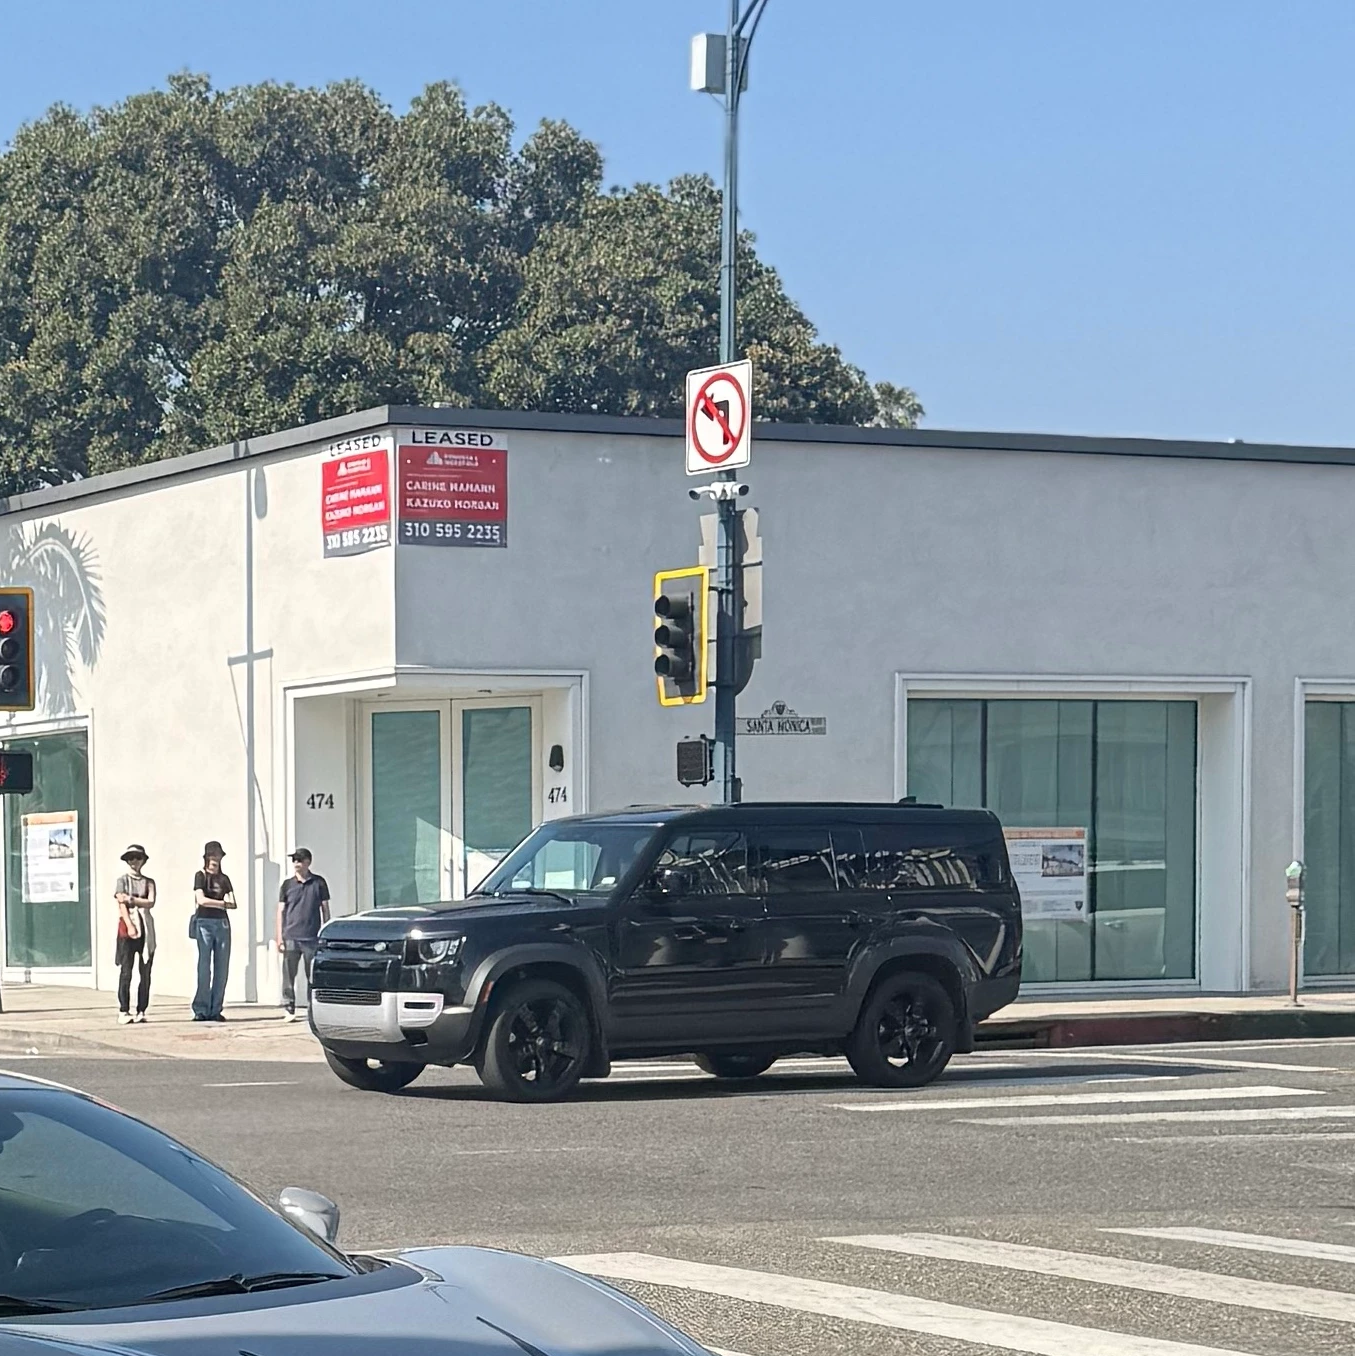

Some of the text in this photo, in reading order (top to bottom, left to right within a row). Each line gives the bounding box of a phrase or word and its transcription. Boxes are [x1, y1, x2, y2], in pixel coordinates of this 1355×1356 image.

[330, 434, 381, 457] LEASED
[412, 430, 493, 446] LEASED
[405, 522, 500, 539] 310 595 2235
[746, 719, 774, 733] SANTA
[306, 793, 335, 809] 474
[547, 786, 567, 804] 474
